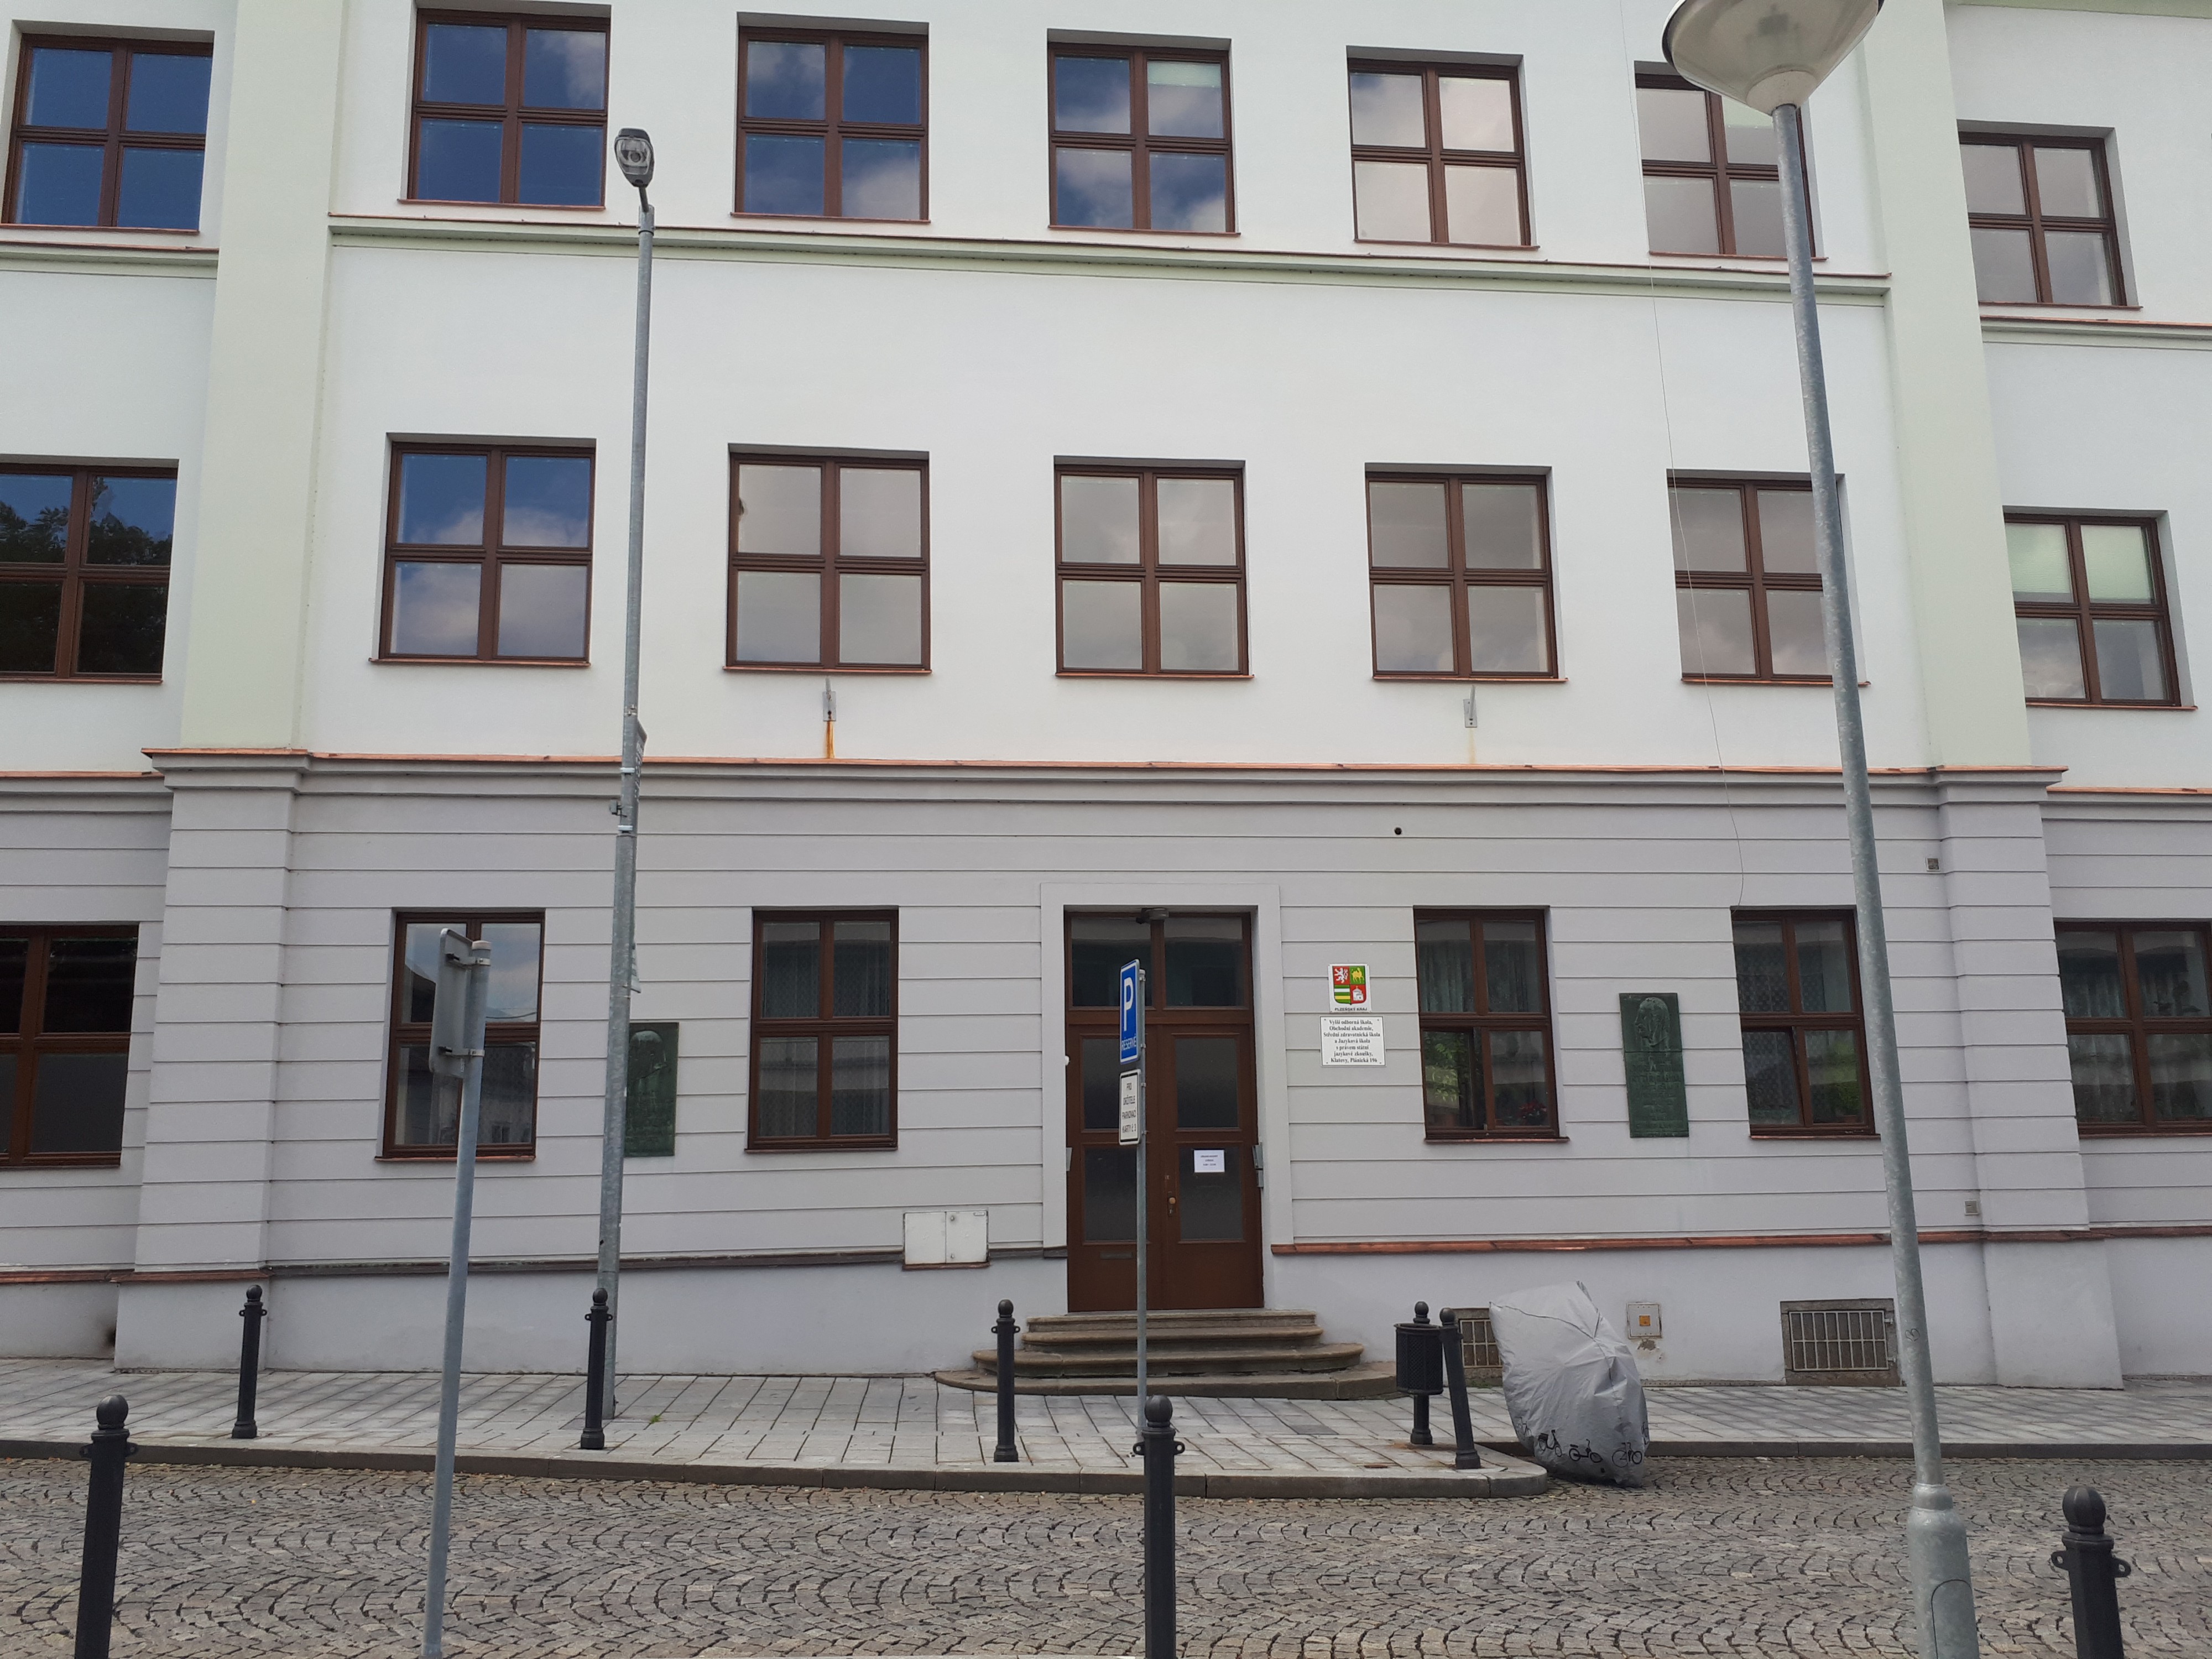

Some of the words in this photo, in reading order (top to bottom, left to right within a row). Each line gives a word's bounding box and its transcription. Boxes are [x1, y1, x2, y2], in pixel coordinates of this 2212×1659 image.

[1124, 977, 1134, 1031] P
[1121, 1033, 1136, 1051] RÉSERVÉ
[1122, 1124, 1131, 1133] KARTY
